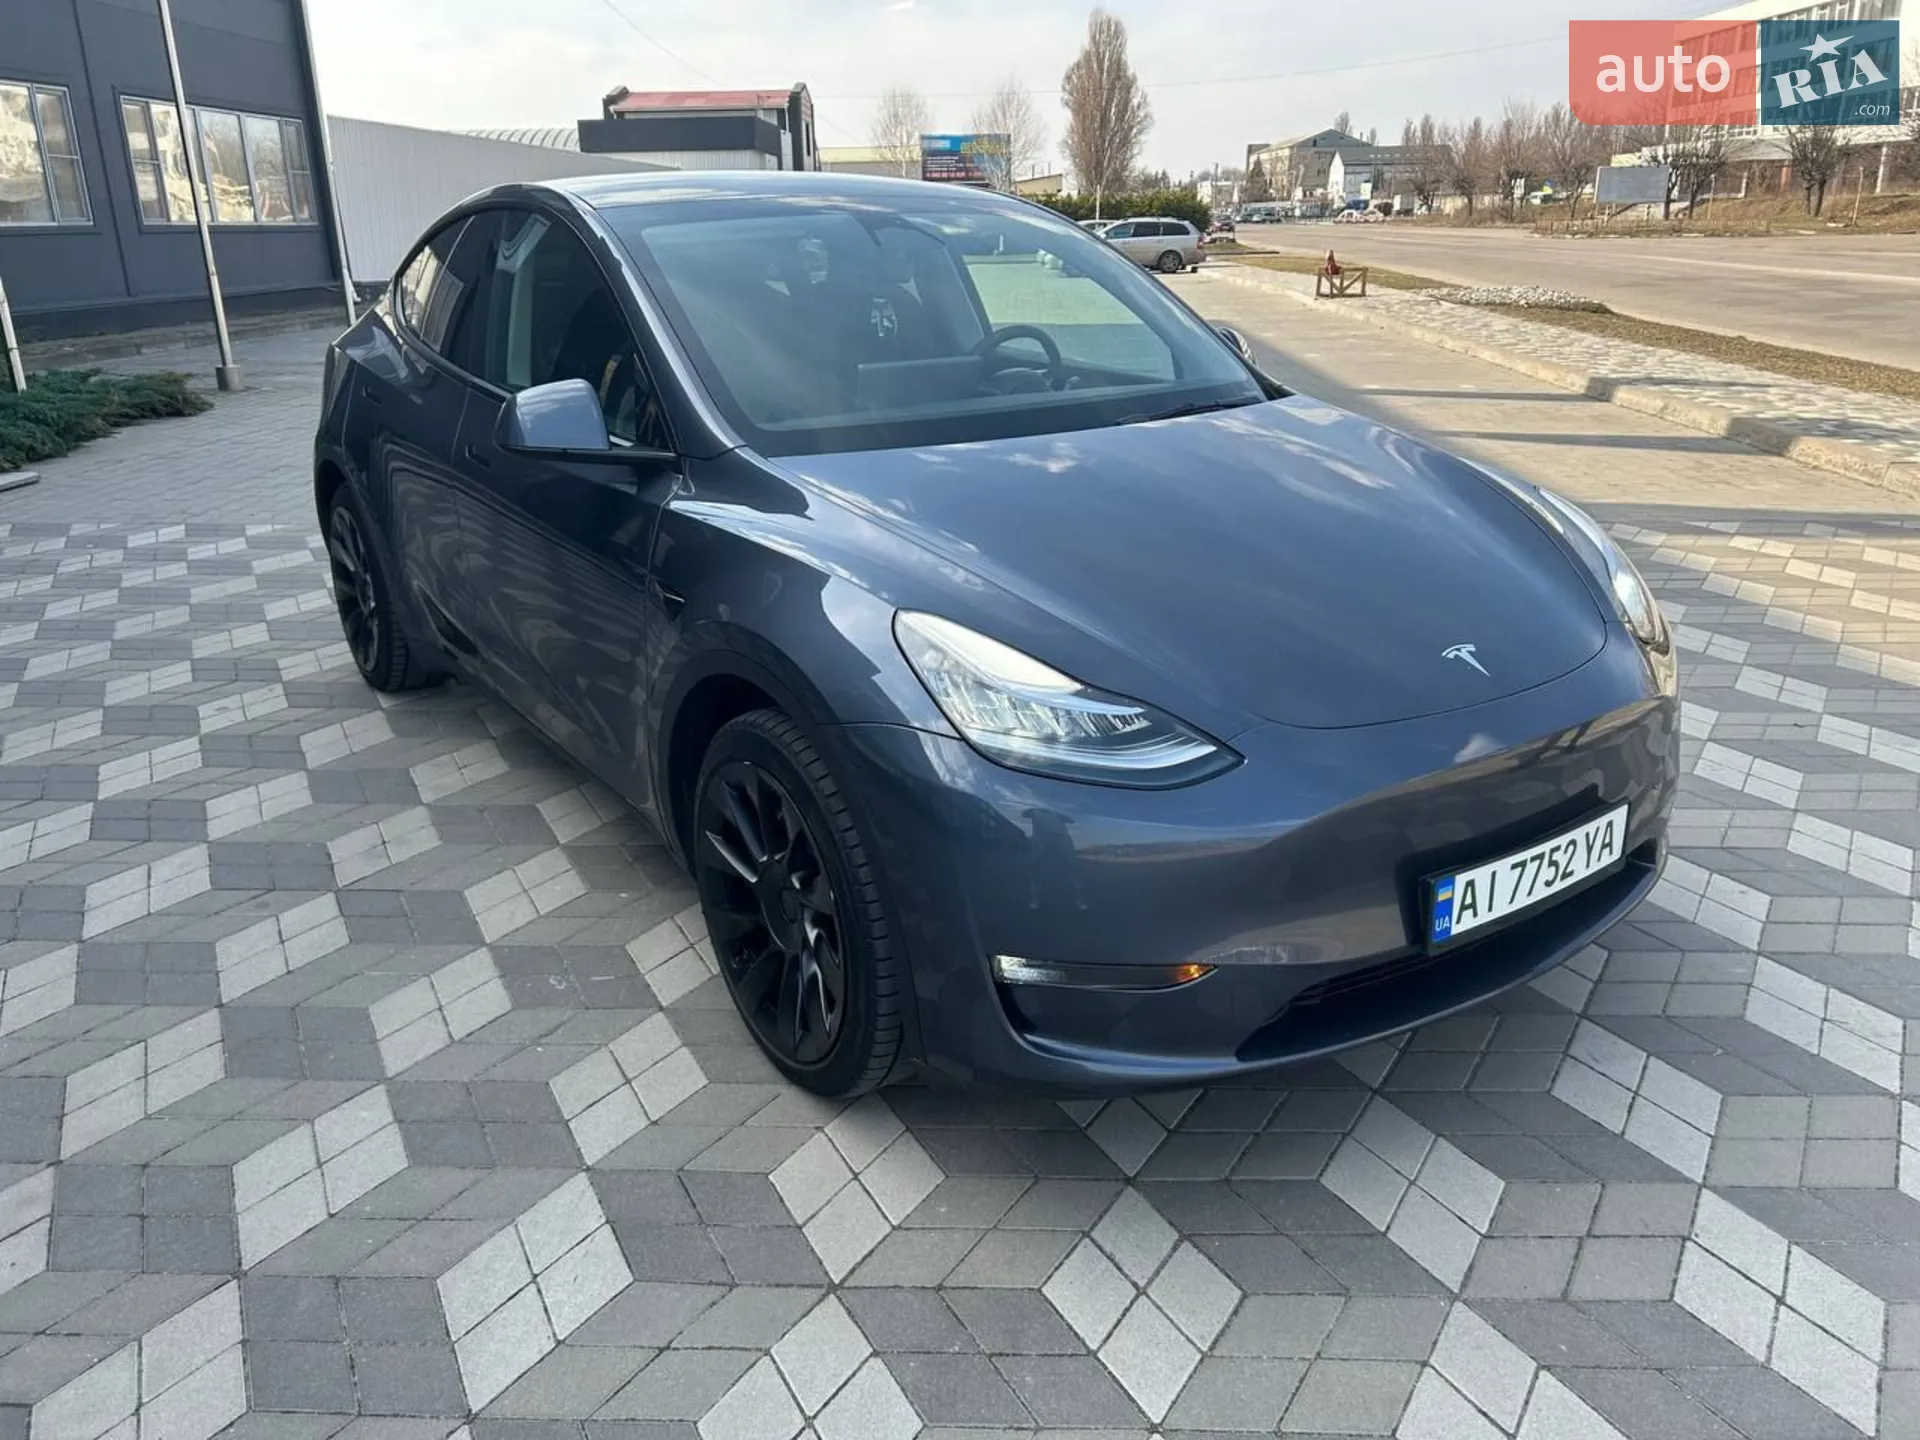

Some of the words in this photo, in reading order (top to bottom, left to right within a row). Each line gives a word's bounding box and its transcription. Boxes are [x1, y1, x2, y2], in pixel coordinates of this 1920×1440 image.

[1455, 870, 1497, 925] AI
[1508, 838, 1578, 906] 7752
[1584, 819, 1615, 870] YA
[1434, 915, 1451, 932] UA
